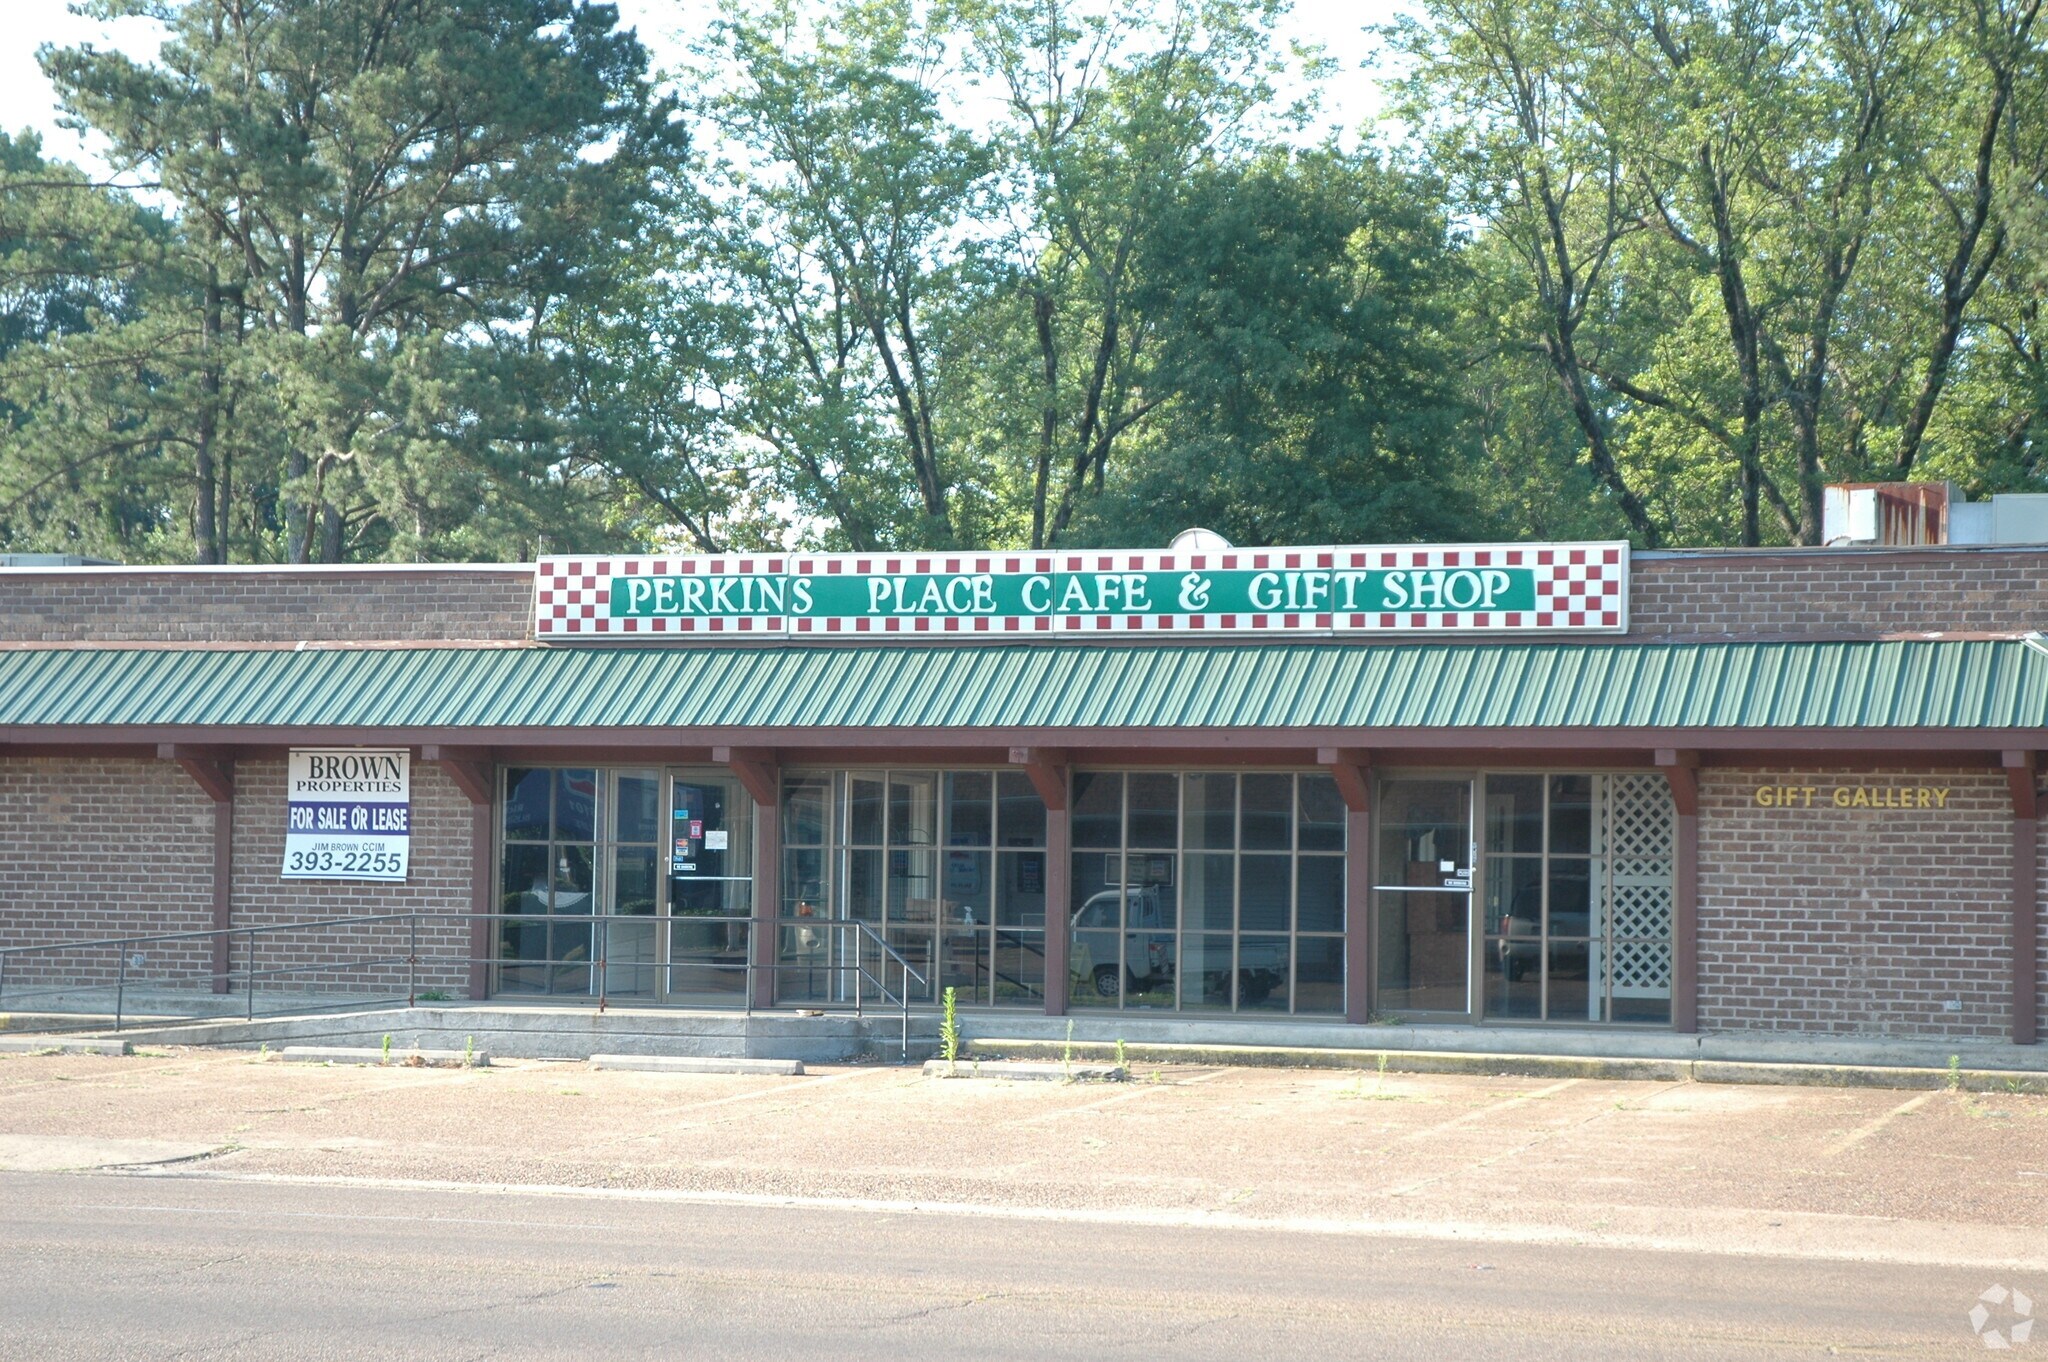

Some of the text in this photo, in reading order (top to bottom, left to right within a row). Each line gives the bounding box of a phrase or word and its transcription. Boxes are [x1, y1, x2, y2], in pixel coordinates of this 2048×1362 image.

[627, 569, 1511, 615] PERKINS PLACE CAFE & GIFT SHOP
[309, 755, 402, 780] BROWN
[296, 780, 402, 793] PROPERTIES
[1756, 786, 1950, 808] GIFT GALLERY
[290, 806, 407, 831] FOR SALE OR LEASE
[311, 842, 385, 852] JIM BROWN CCIM
[289, 851, 402, 873] 393-2255
